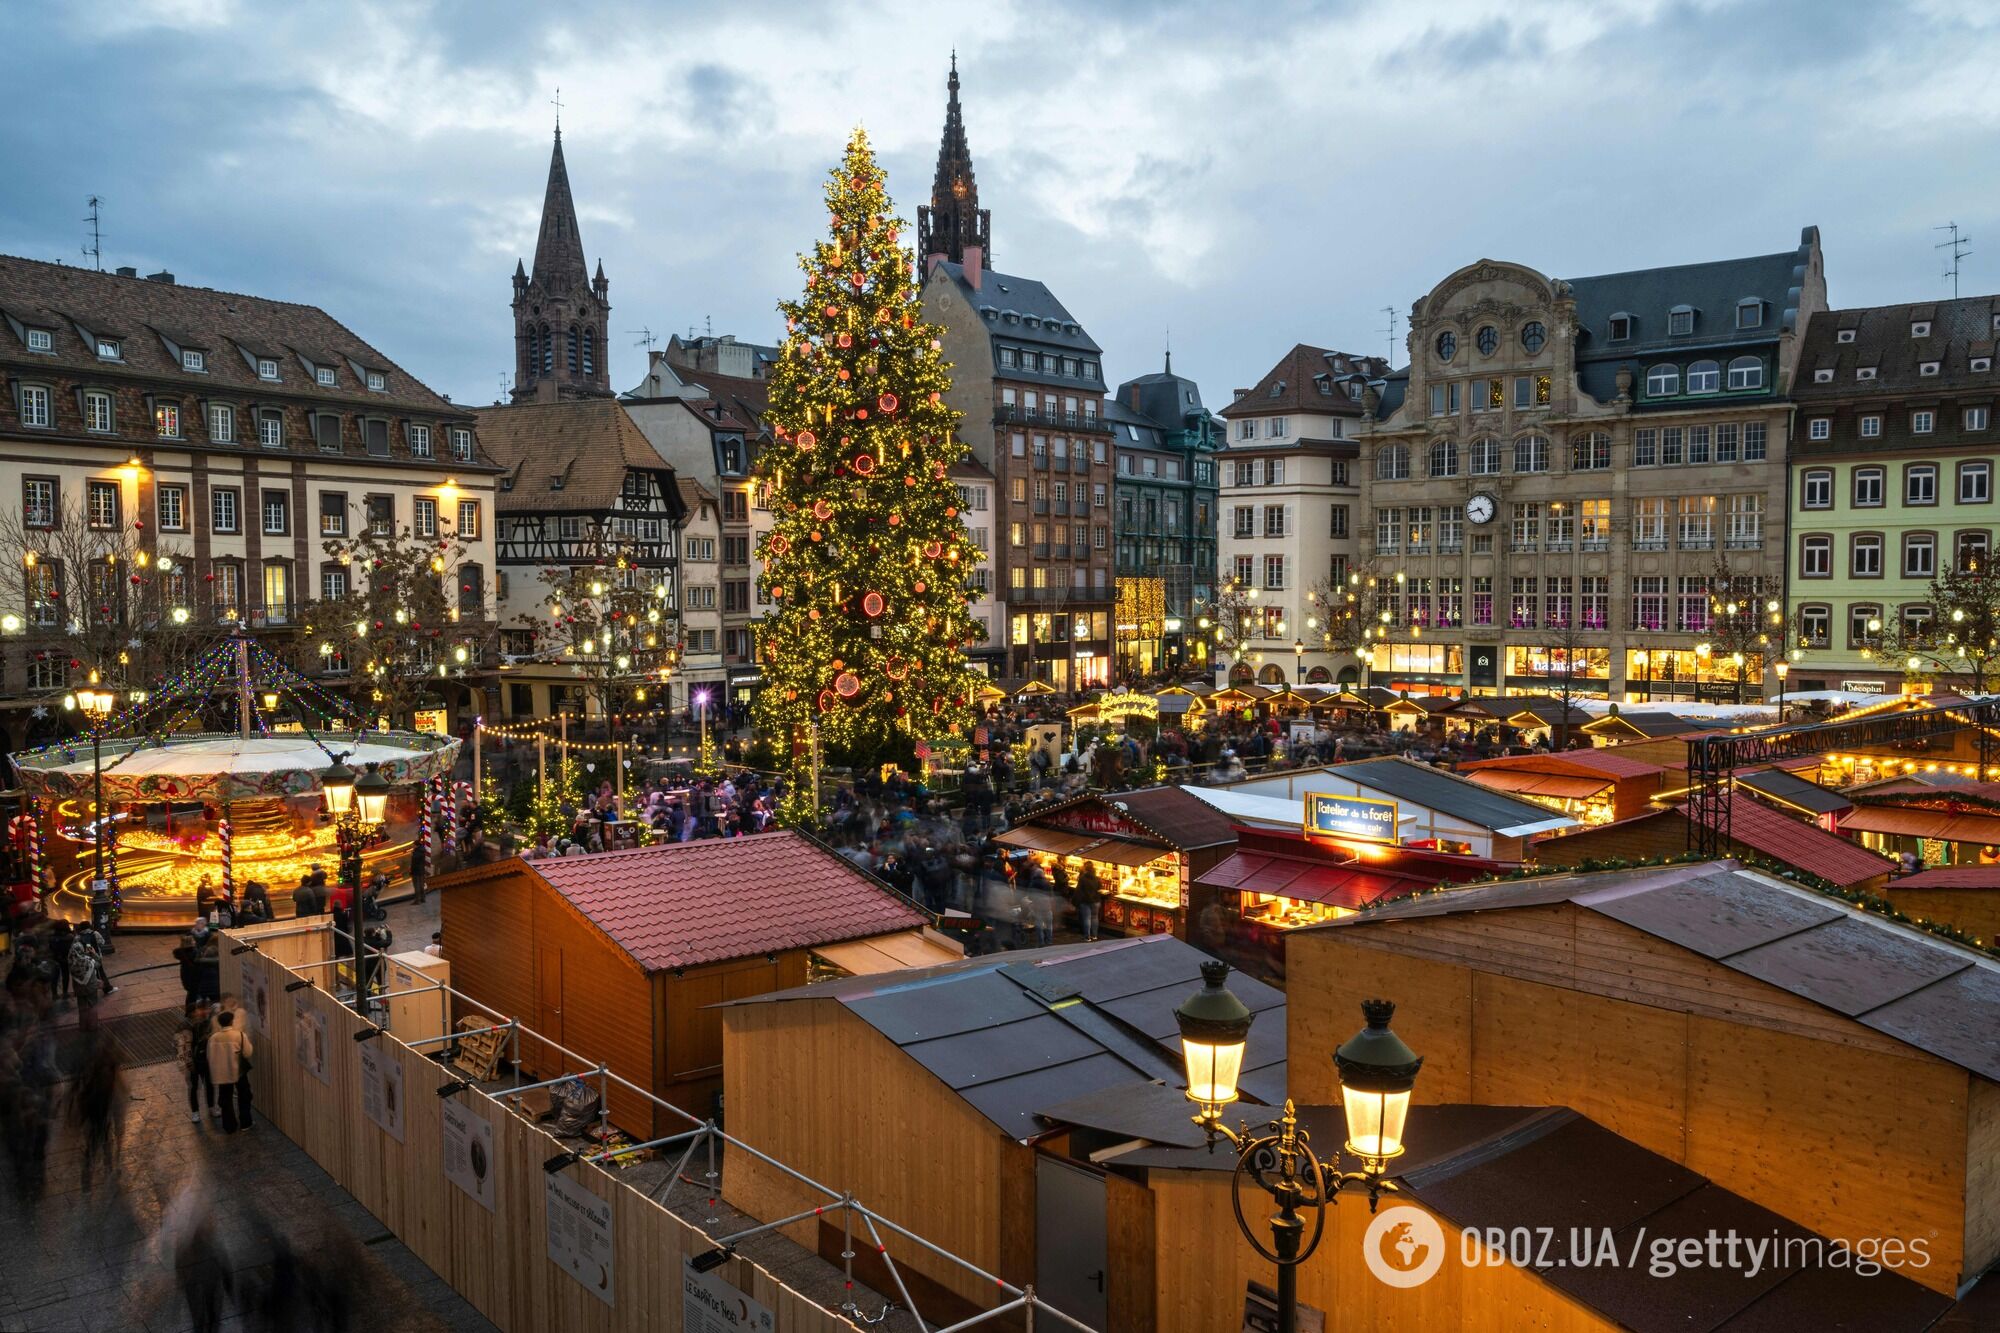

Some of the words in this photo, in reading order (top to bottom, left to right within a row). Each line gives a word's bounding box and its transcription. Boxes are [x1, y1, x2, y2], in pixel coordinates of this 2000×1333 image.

[1318, 801, 1349, 817] l'atelier
[1369, 808, 1393, 822] forêt
[685, 1280, 693, 1294] LE
[711, 1299, 720, 1313] DE
